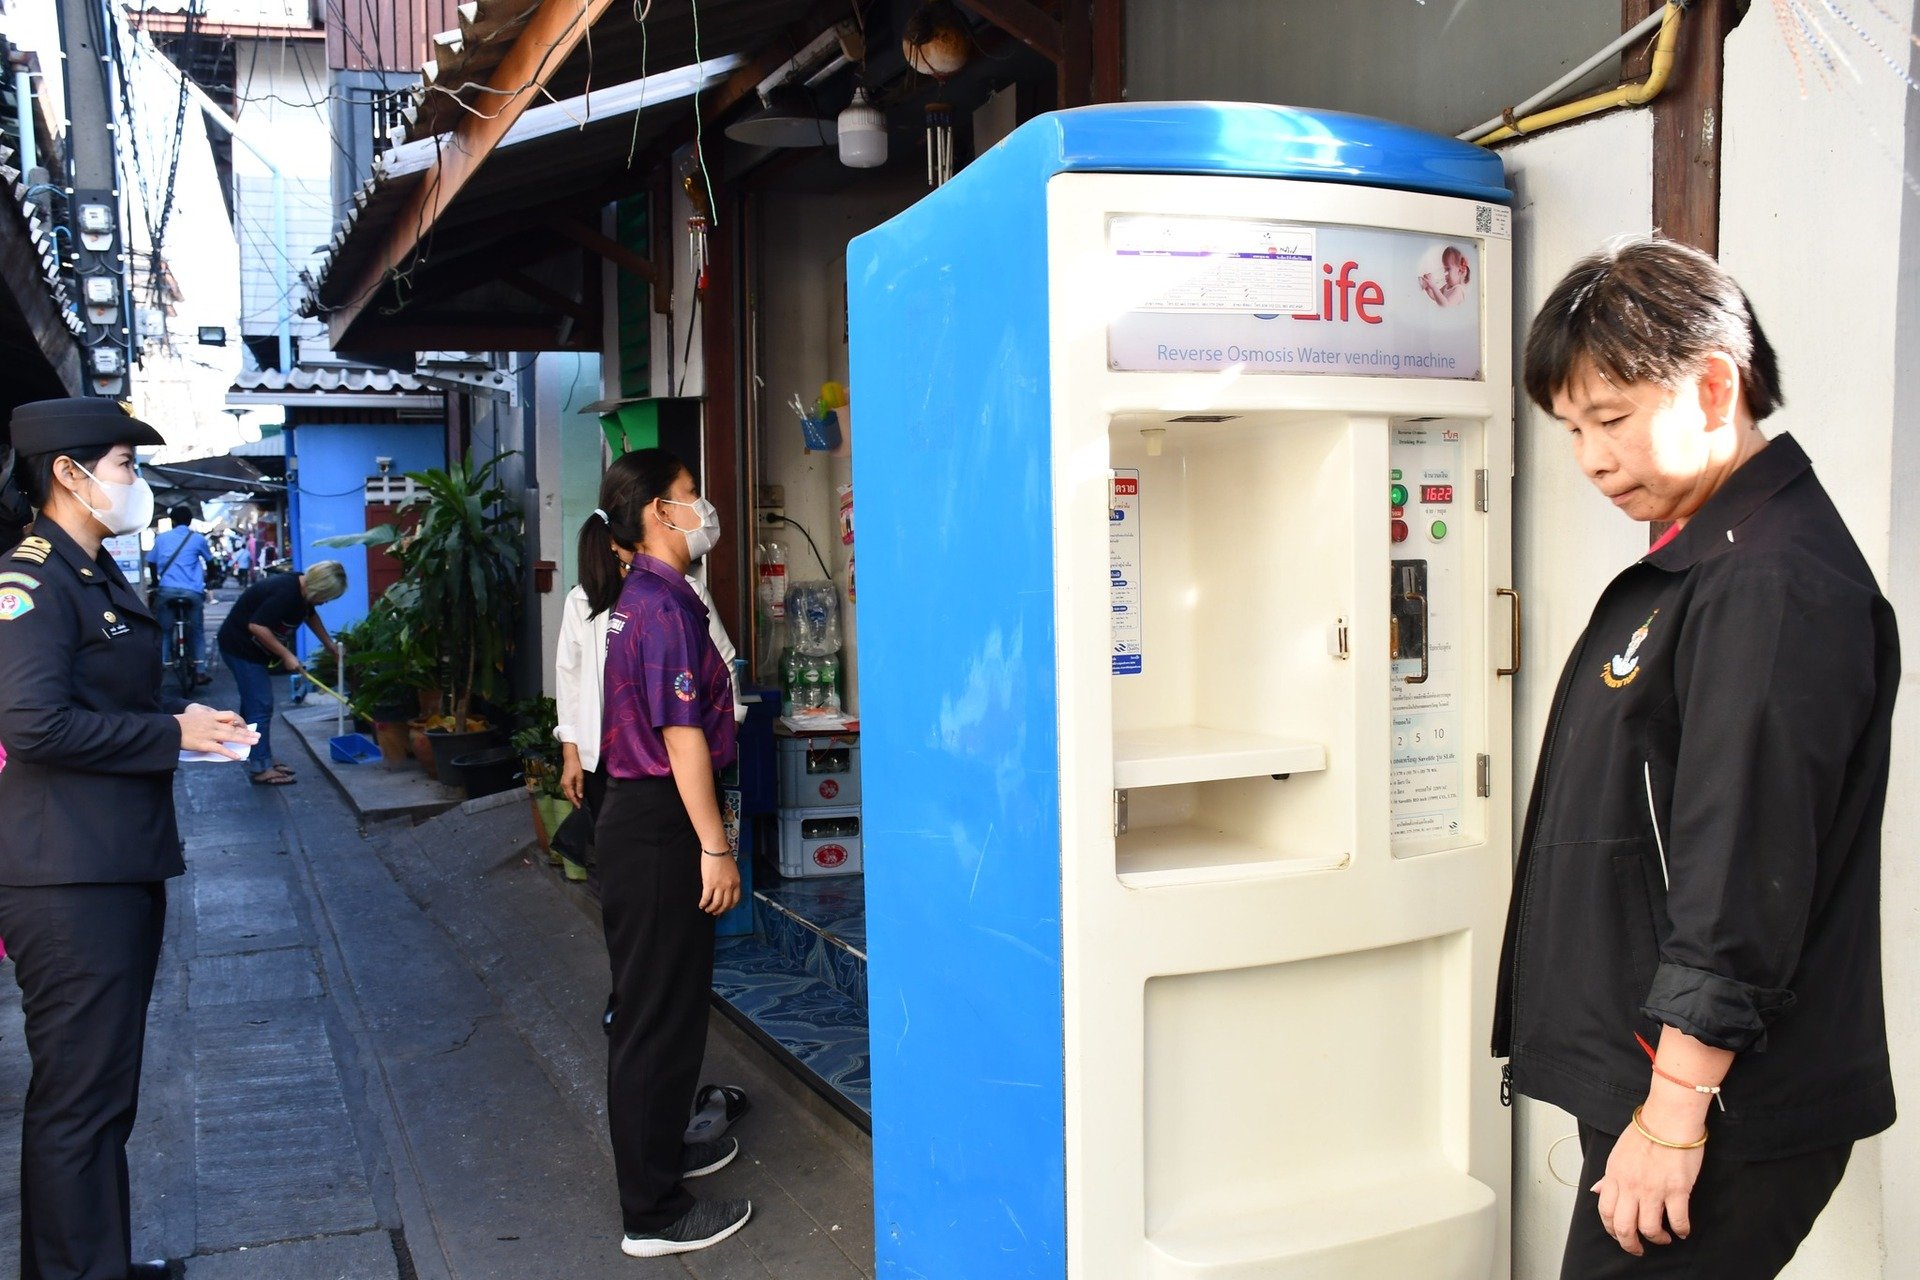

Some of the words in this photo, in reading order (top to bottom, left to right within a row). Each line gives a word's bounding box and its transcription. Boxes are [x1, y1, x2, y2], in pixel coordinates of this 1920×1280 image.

[1291, 261, 1385, 324] ife
[1157, 344, 1223, 361] Reverse
[1227, 345, 1294, 363] Osmosis
[1297, 347, 1341, 364] Water
[1344, 350, 1400, 370] vending
[1403, 352, 1456, 369] machine
[1426, 487, 1452, 501] 1622
[1397, 736, 1403, 746] 2
[1415, 732, 1421, 743] 5
[1434, 728, 1445, 739] 10
